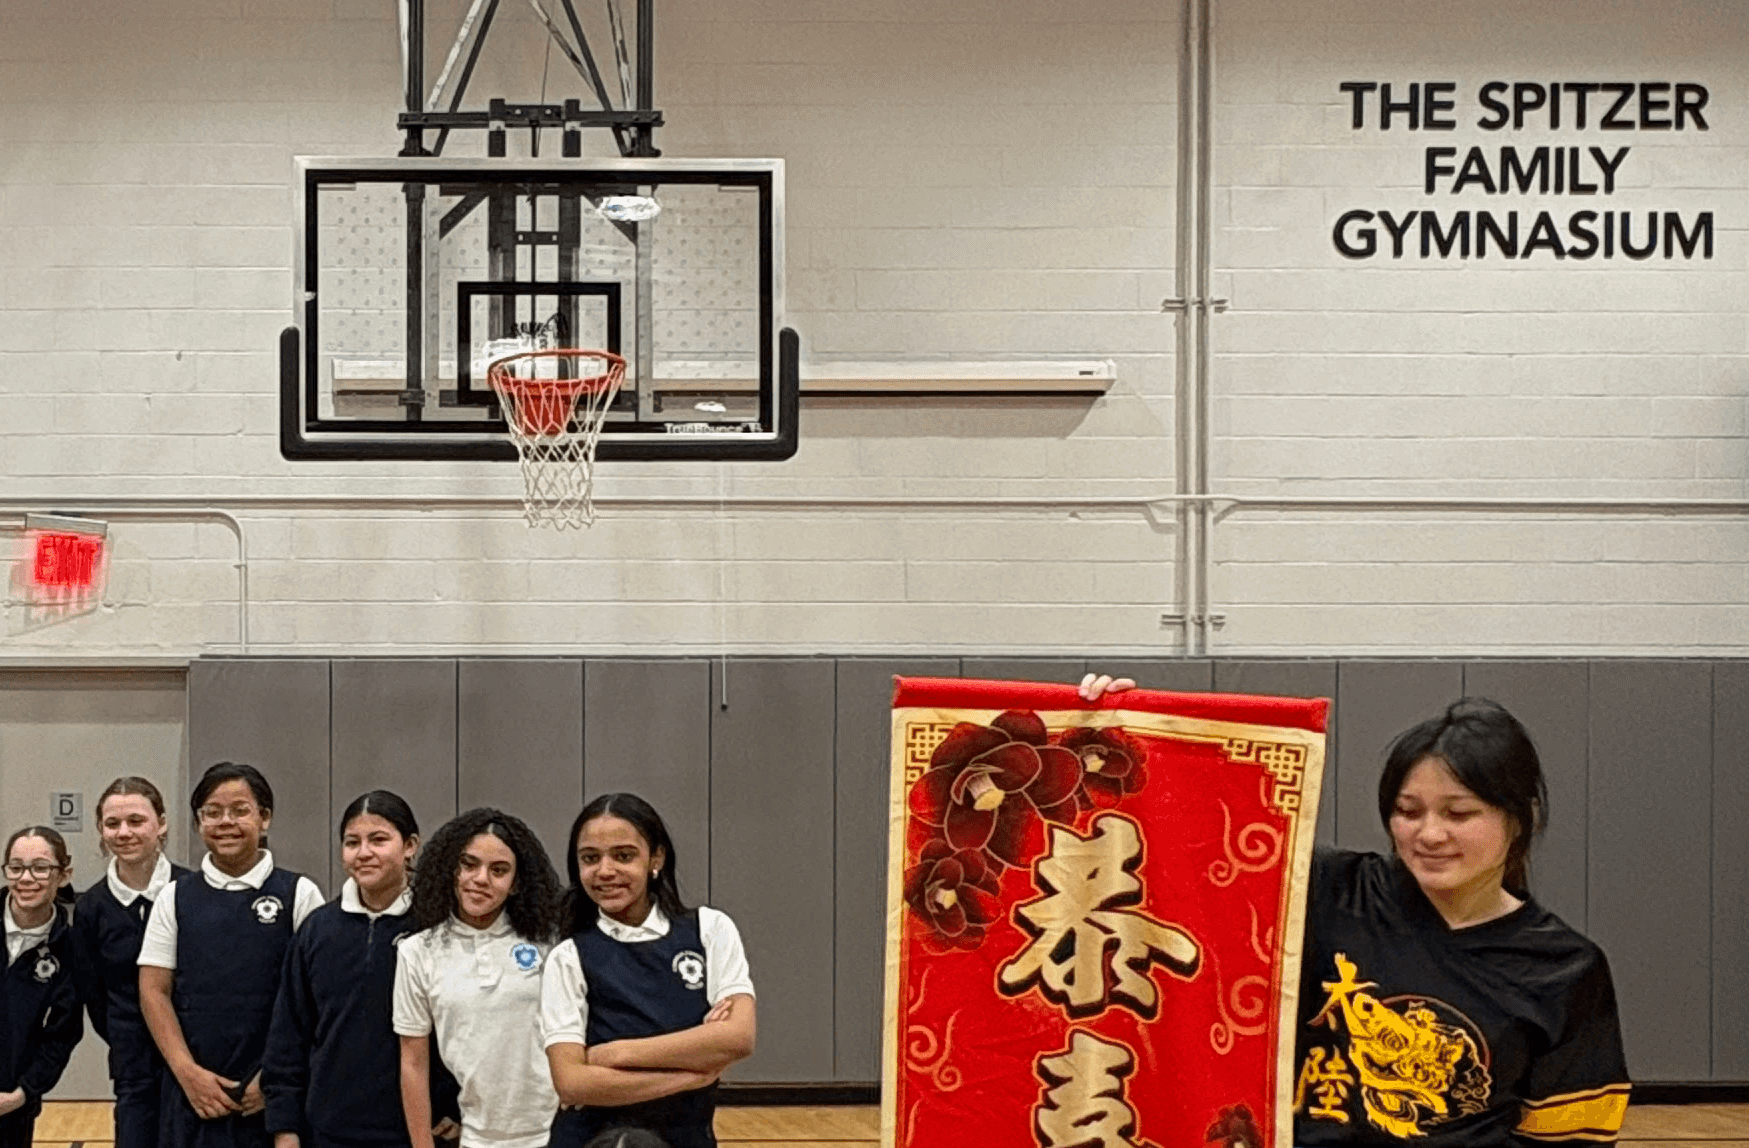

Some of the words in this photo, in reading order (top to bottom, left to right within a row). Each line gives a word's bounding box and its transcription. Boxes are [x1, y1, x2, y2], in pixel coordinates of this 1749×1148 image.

[1340, 82, 1456, 130] THE
[1477, 81, 1709, 131] SPITZER
[1425, 146, 1630, 195] FAMILY
[1333, 210, 1713, 260] GYMNASIUM
[59, 799, 74, 816] D
